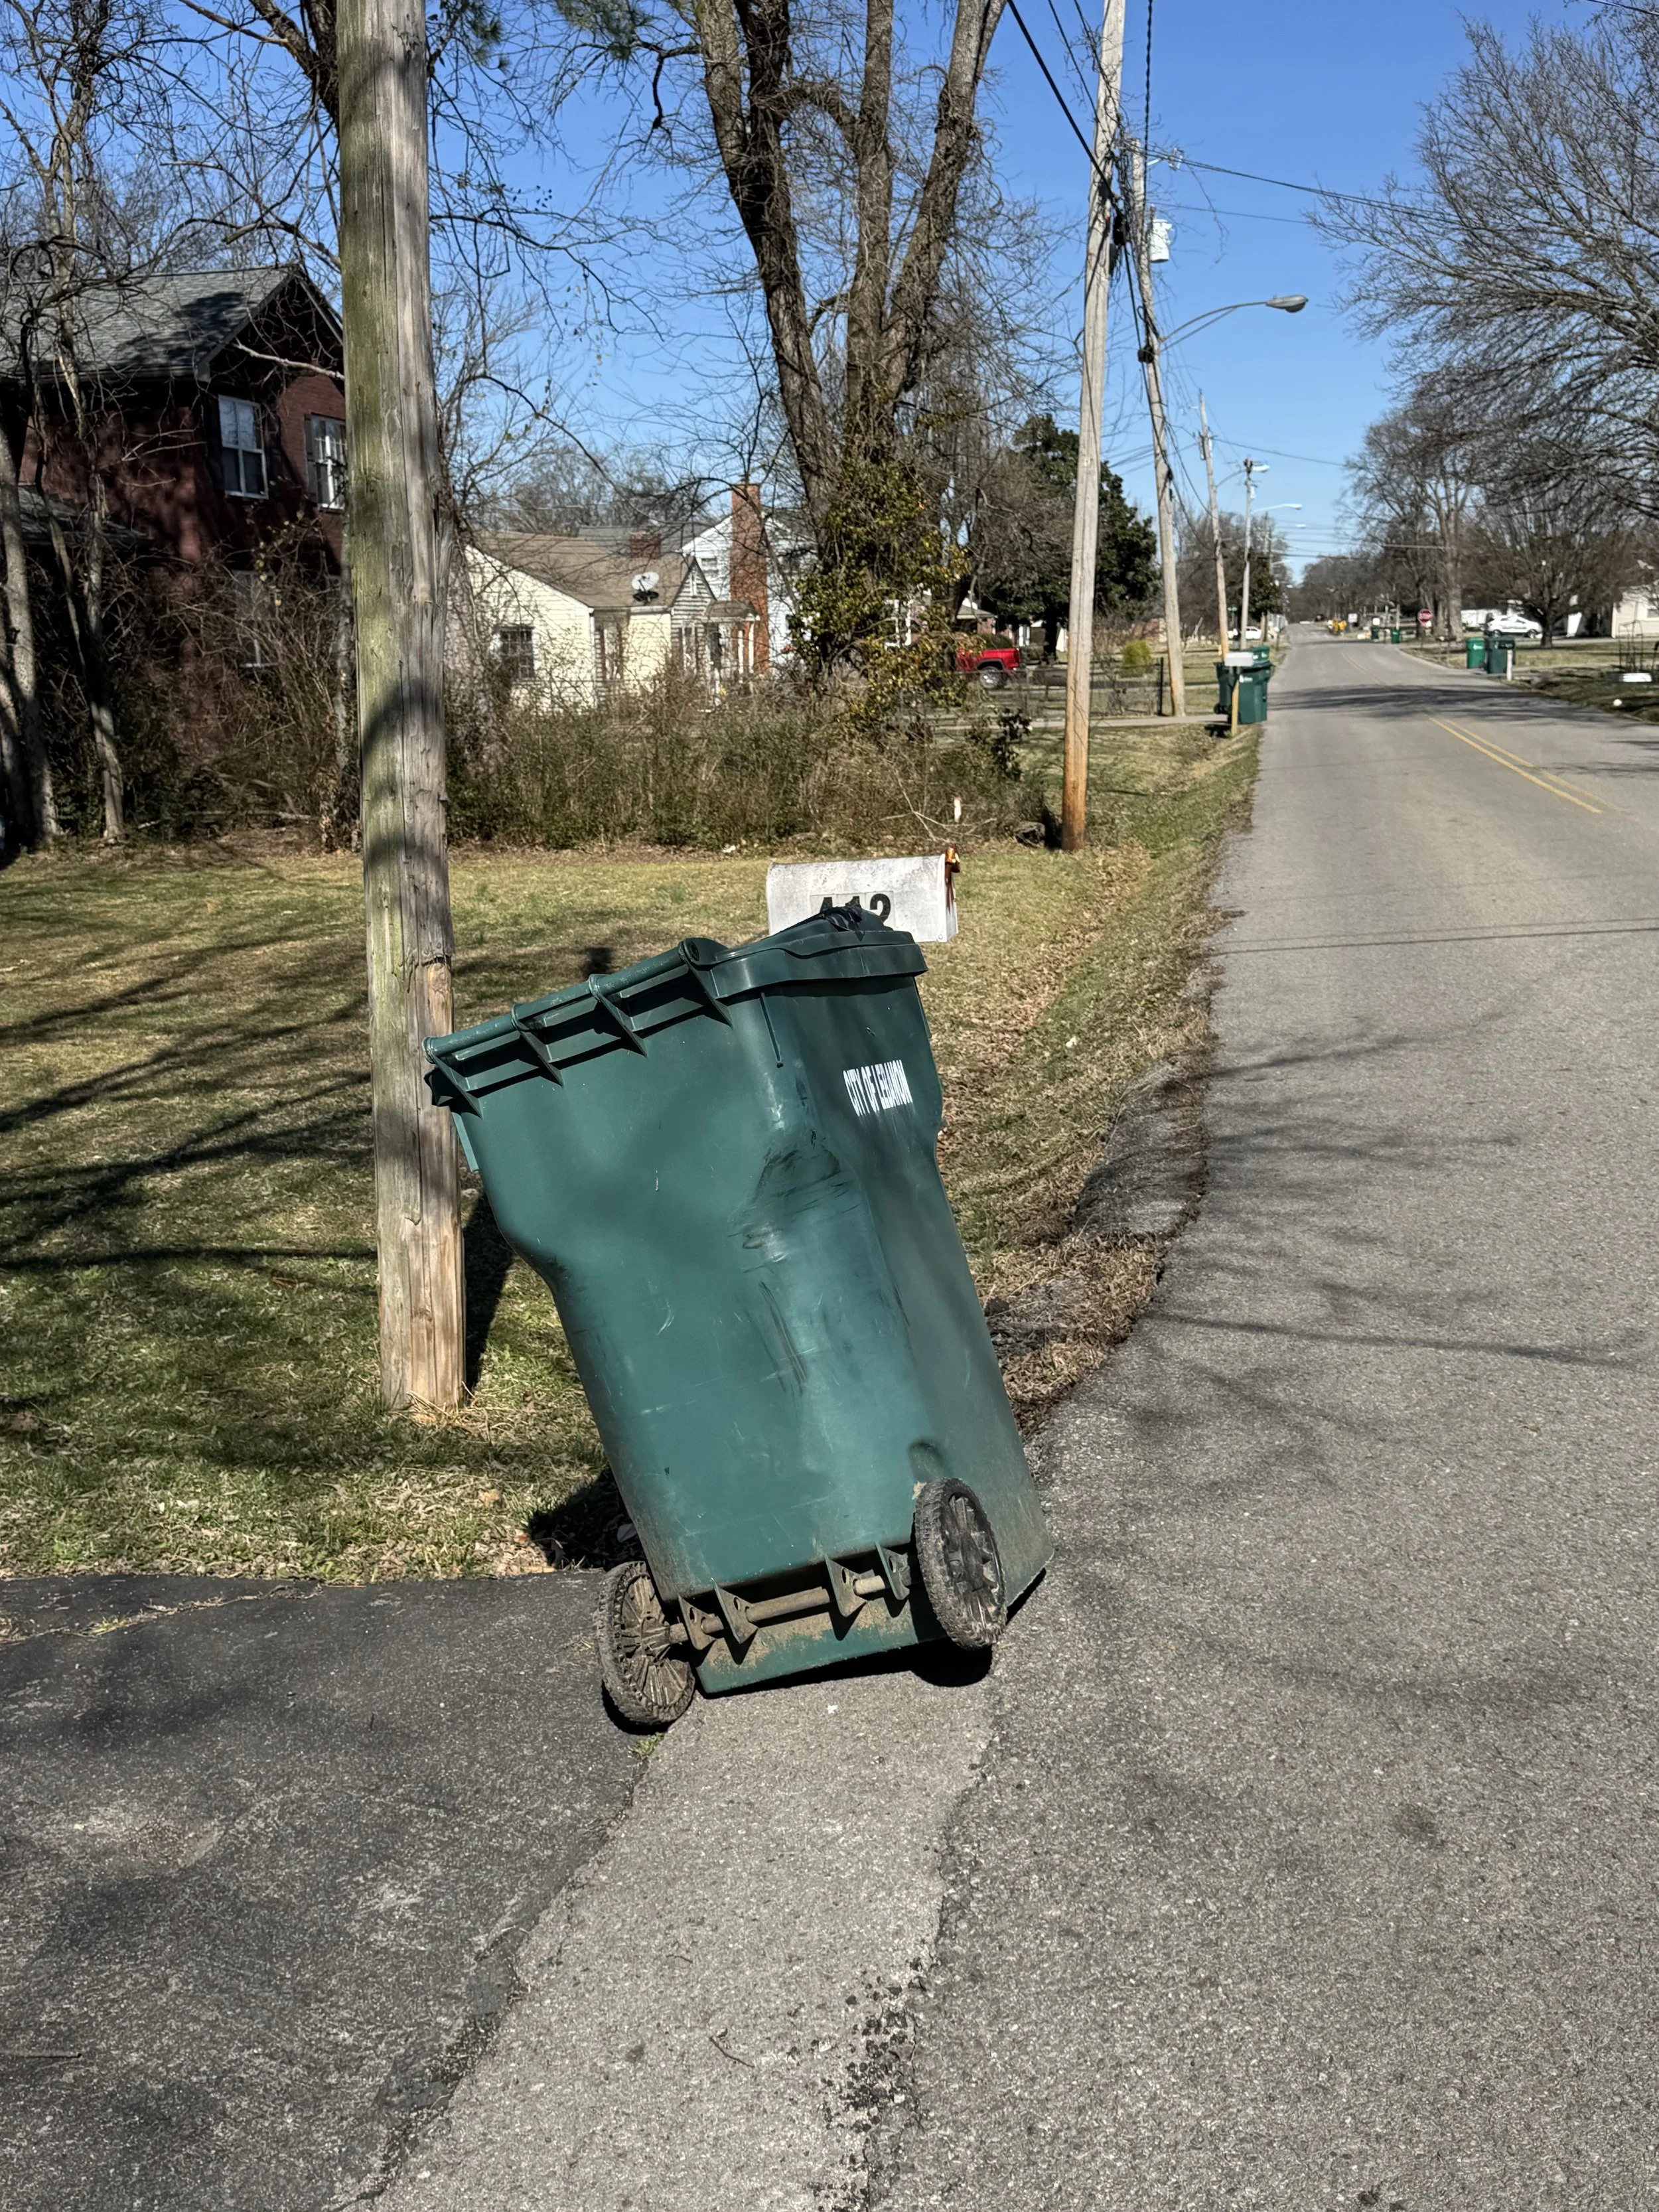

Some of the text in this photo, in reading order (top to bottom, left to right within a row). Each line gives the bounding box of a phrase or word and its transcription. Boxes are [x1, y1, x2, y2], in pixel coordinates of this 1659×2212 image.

[843, 1060, 912, 1116] CITY OF LEBANON
